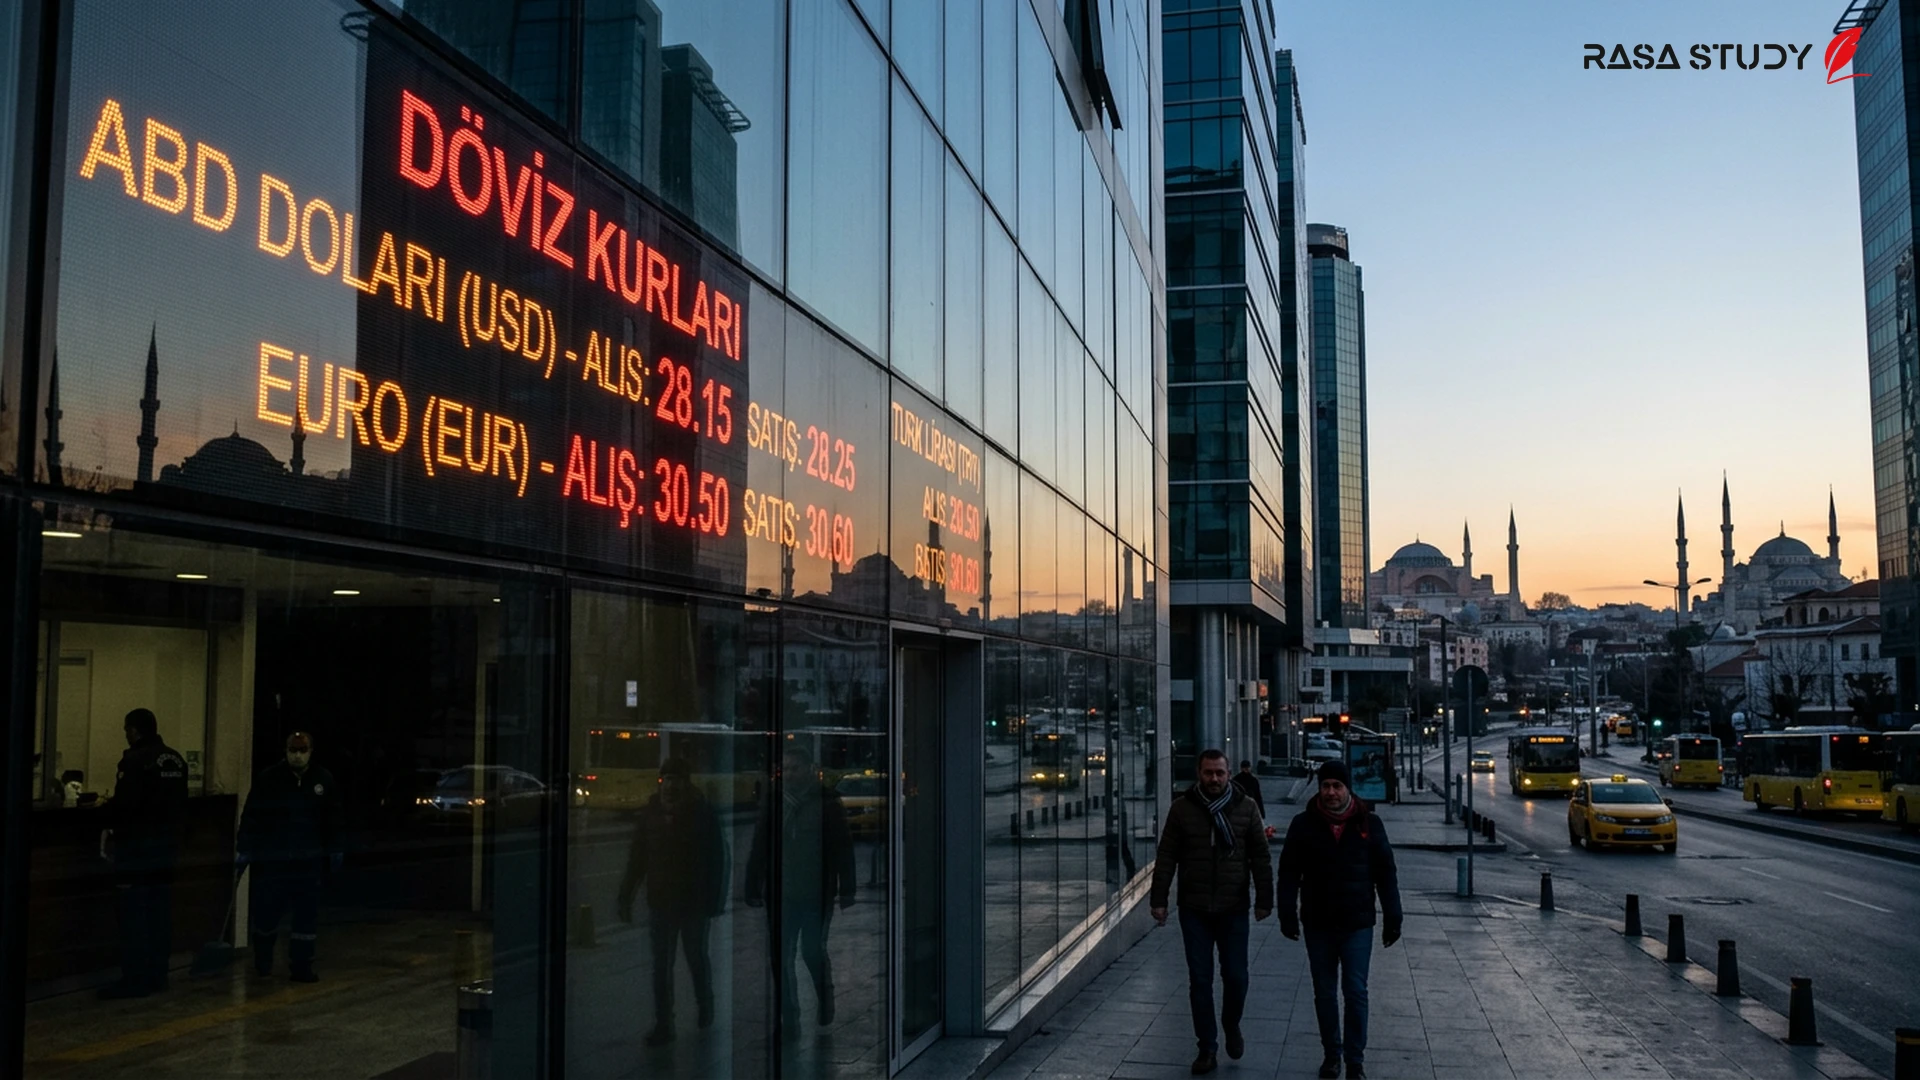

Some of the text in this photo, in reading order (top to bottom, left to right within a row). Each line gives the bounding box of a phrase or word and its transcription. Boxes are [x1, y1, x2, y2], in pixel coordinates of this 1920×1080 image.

[80, 98, 238, 233] ABD
[258, 173, 446, 323] DOLARI
[459, 270, 556, 379] (USD)
[583, 330, 650, 406] ALIS:
[656, 356, 733, 445] 28.15
[747, 401, 803, 473] SATIŞ:
[806, 423, 856, 493] 28.25
[400, 89, 742, 361] DÖVİZ KURLARI
[257, 341, 409, 453] EURO
[422, 395, 530, 498] (EUR)
[562, 433, 645, 529] ALIŞ:
[654, 457, 730, 537] 30.50
[805, 503, 855, 567] 30.60
